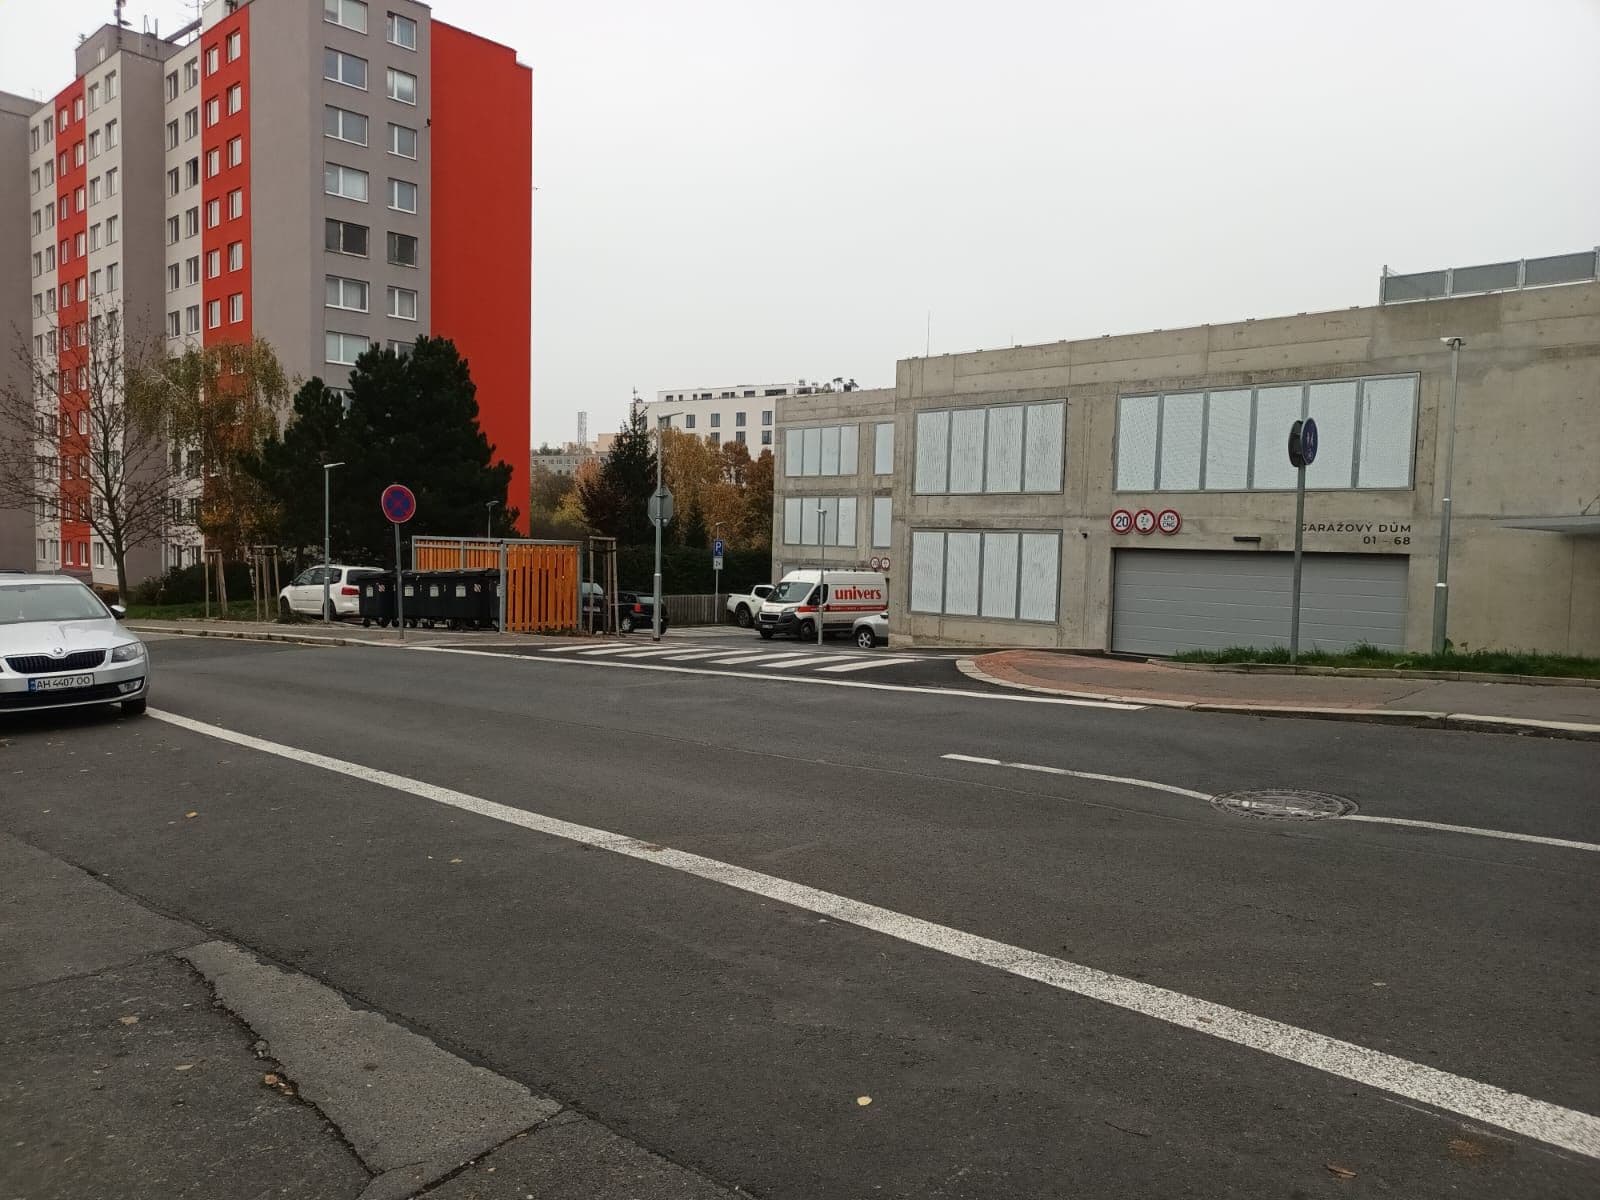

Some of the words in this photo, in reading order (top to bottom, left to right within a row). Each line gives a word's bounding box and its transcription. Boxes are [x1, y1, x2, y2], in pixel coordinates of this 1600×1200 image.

[1115, 516, 1129, 527] 20
[1378, 521, 1411, 533] DŮM
[1363, 536, 1377, 545] 01
[1393, 536, 1411, 545] 68
[834, 585, 882, 600] univers
[37, 680, 51, 689] AH
[52, 677, 74, 688] 4407
